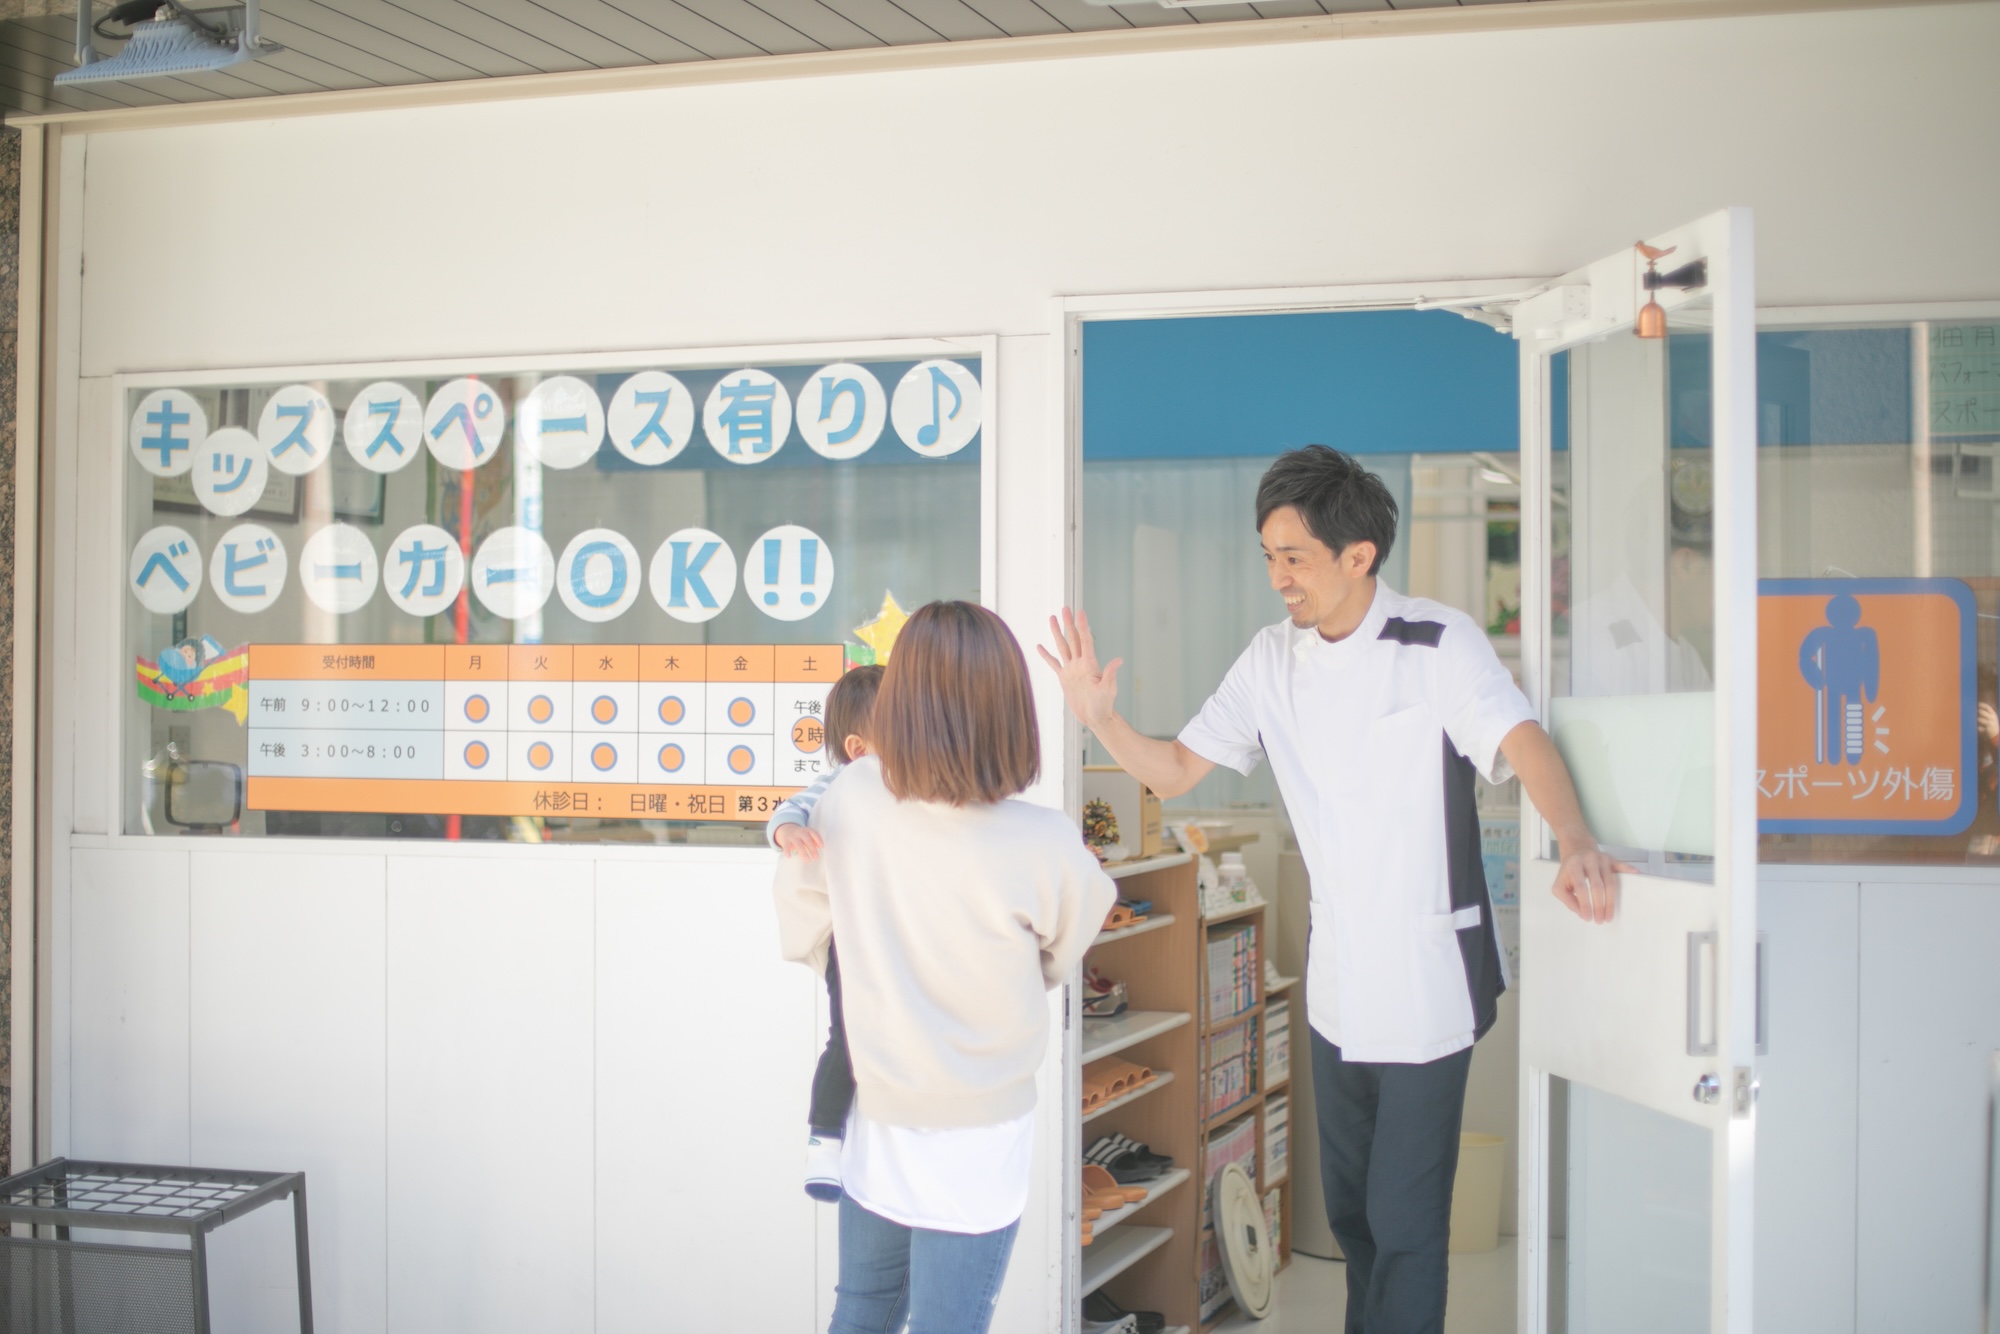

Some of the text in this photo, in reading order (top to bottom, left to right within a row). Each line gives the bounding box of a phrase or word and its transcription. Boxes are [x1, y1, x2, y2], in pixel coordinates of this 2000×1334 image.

[321, 655, 818, 672] 受付時間 月 火 水 木 金 土
[260, 697, 286, 712] 午前
[793, 699, 822, 715] 午後
[260, 742, 286, 758] 午後
[793, 758, 821, 773] まで
